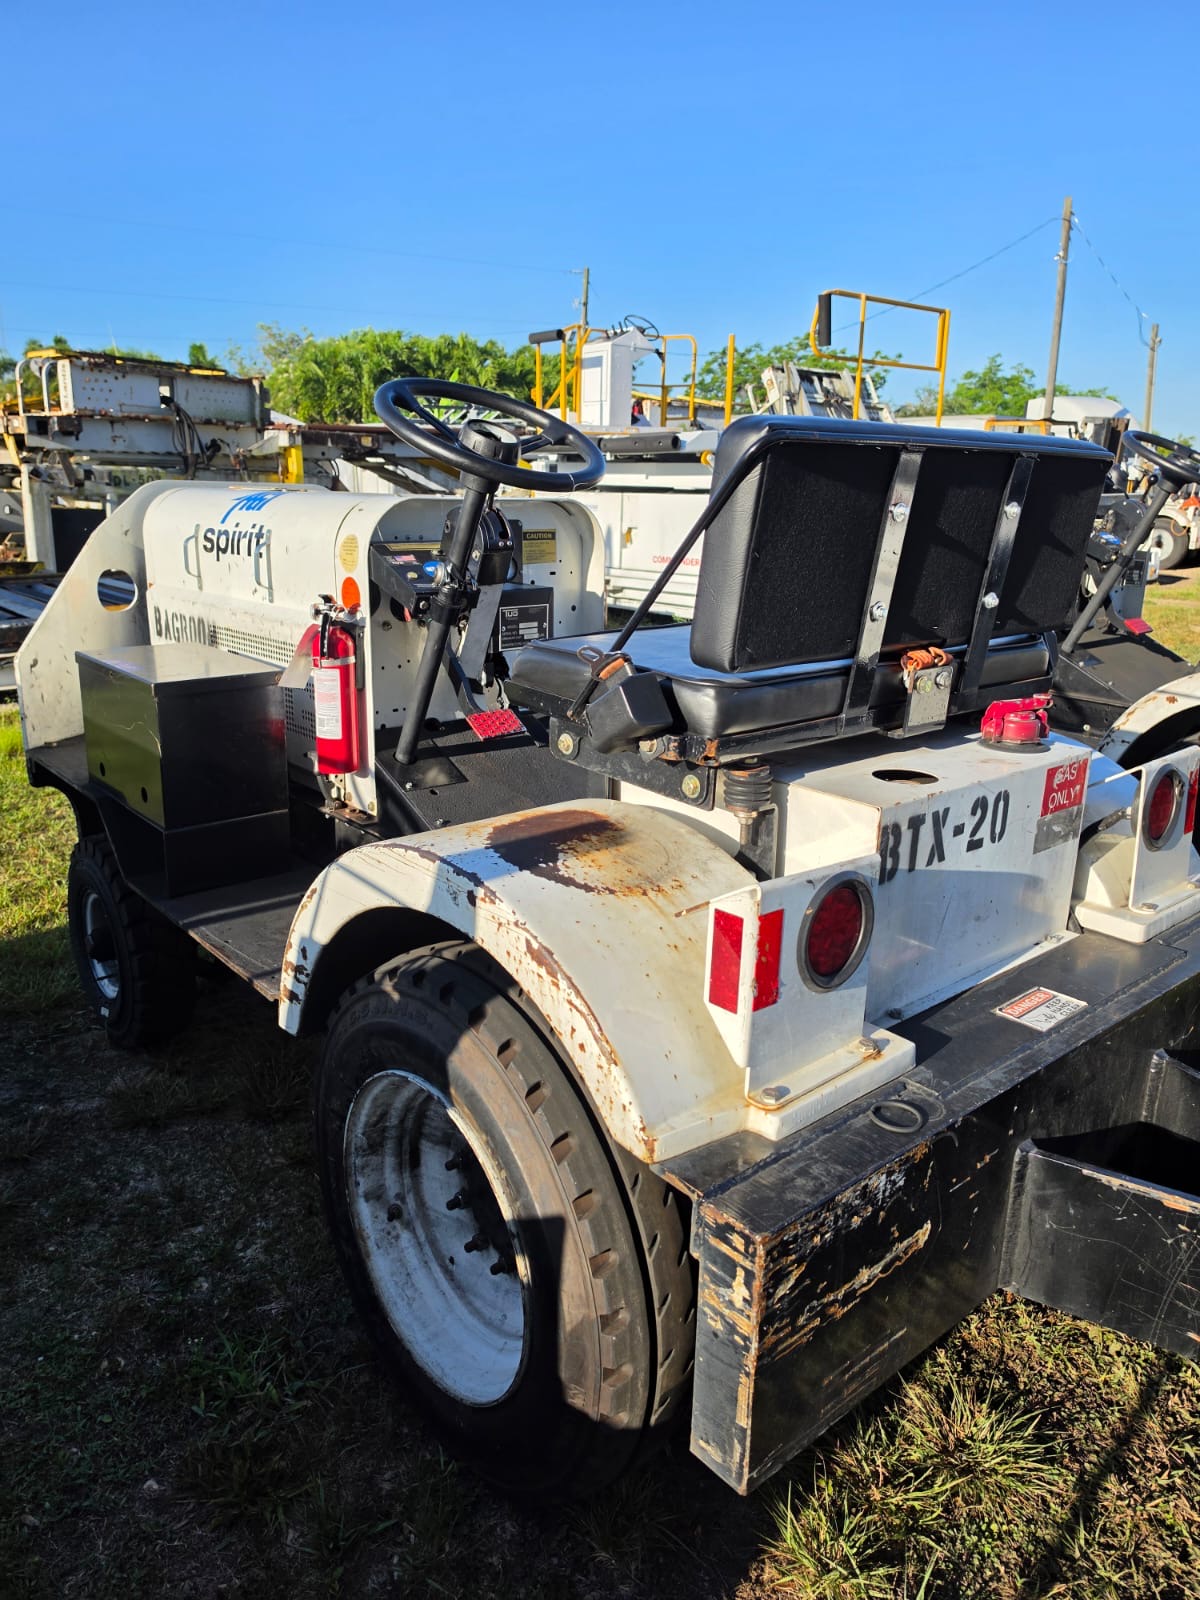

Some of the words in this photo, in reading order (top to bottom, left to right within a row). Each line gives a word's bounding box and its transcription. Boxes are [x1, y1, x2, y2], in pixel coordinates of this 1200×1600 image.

[203, 522, 266, 561] spirit
[526, 532, 553, 540] CAUTION
[1053, 763, 1079, 788] GAS
[1048, 784, 1080, 809] ONLY
[879, 789, 1011, 886] BTX-20
[1008, 992, 1050, 1015] DANGER
